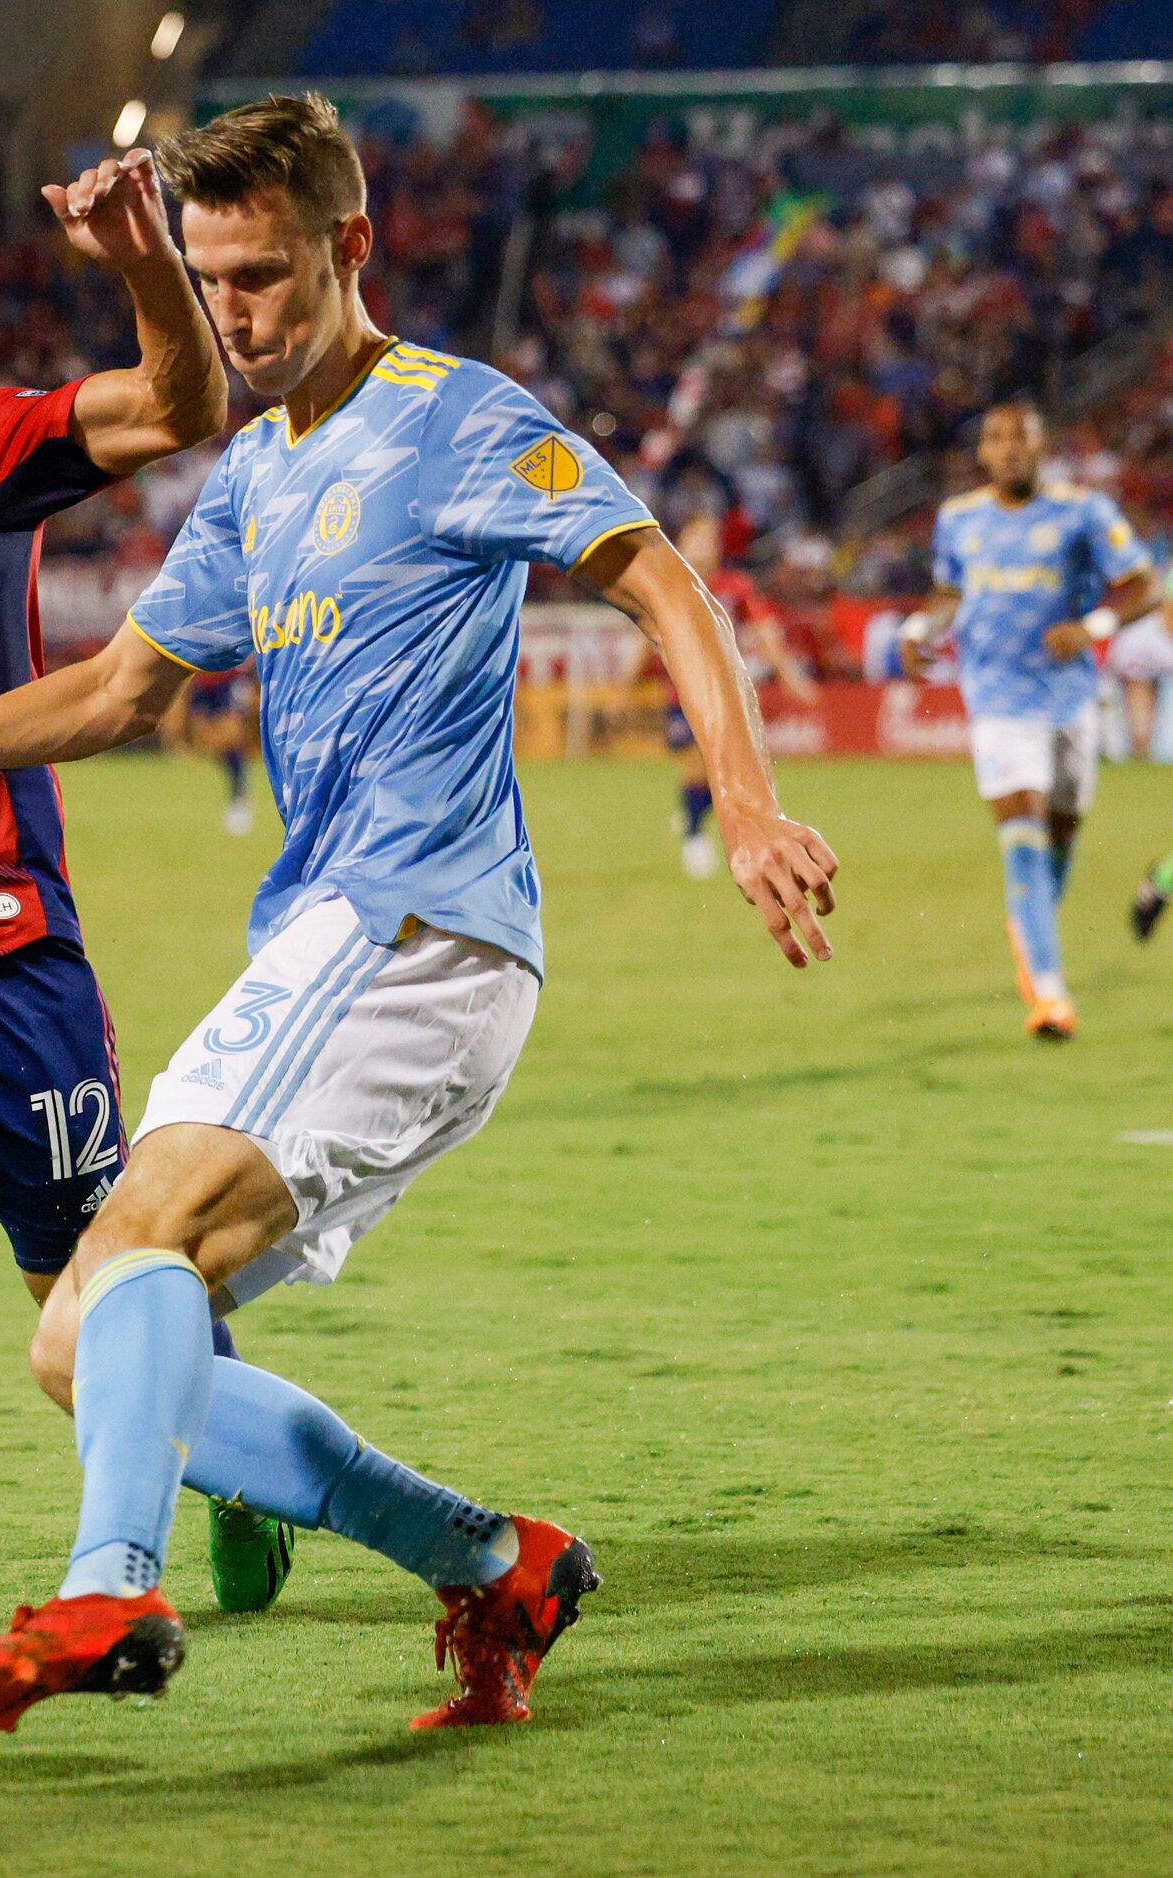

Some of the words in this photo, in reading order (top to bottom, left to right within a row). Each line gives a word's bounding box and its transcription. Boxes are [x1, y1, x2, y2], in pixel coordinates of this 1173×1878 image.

[520, 452, 547, 475] MLS
[203, 981, 292, 1055] 3
[181, 1074, 225, 1091] adidas
[30, 1077, 118, 1180] 12
